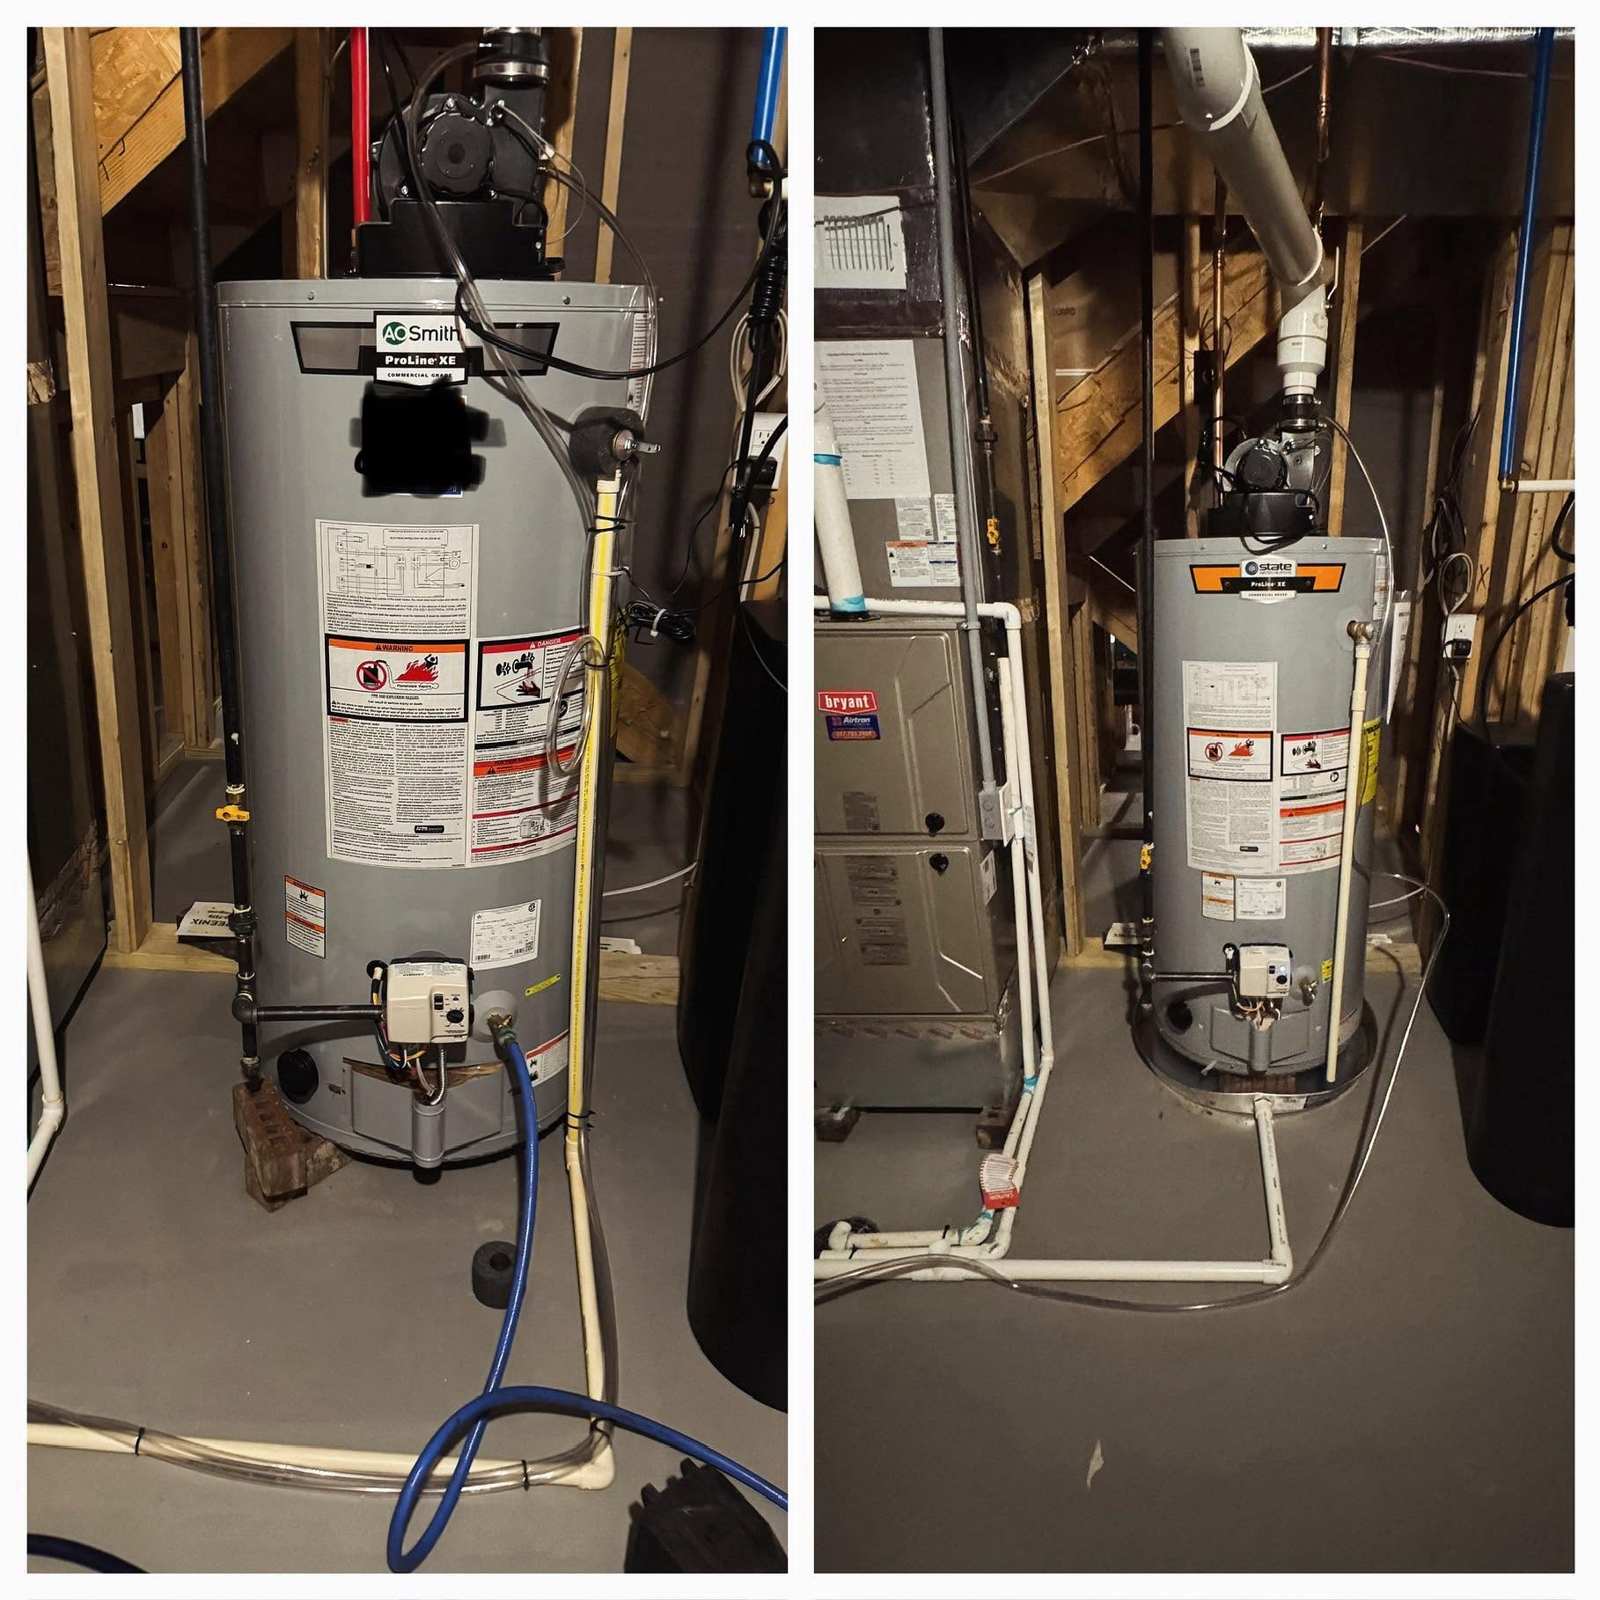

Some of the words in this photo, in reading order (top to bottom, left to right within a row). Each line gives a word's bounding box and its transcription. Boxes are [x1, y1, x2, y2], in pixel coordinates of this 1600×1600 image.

[409, 325, 460, 342] Smith
[385, 355, 435, 365] ProLine
[439, 355, 456, 365] XE
[1259, 563, 1292, 571] state
[537, 638, 561, 647] DANGER
[825, 695, 870, 710] bryant
